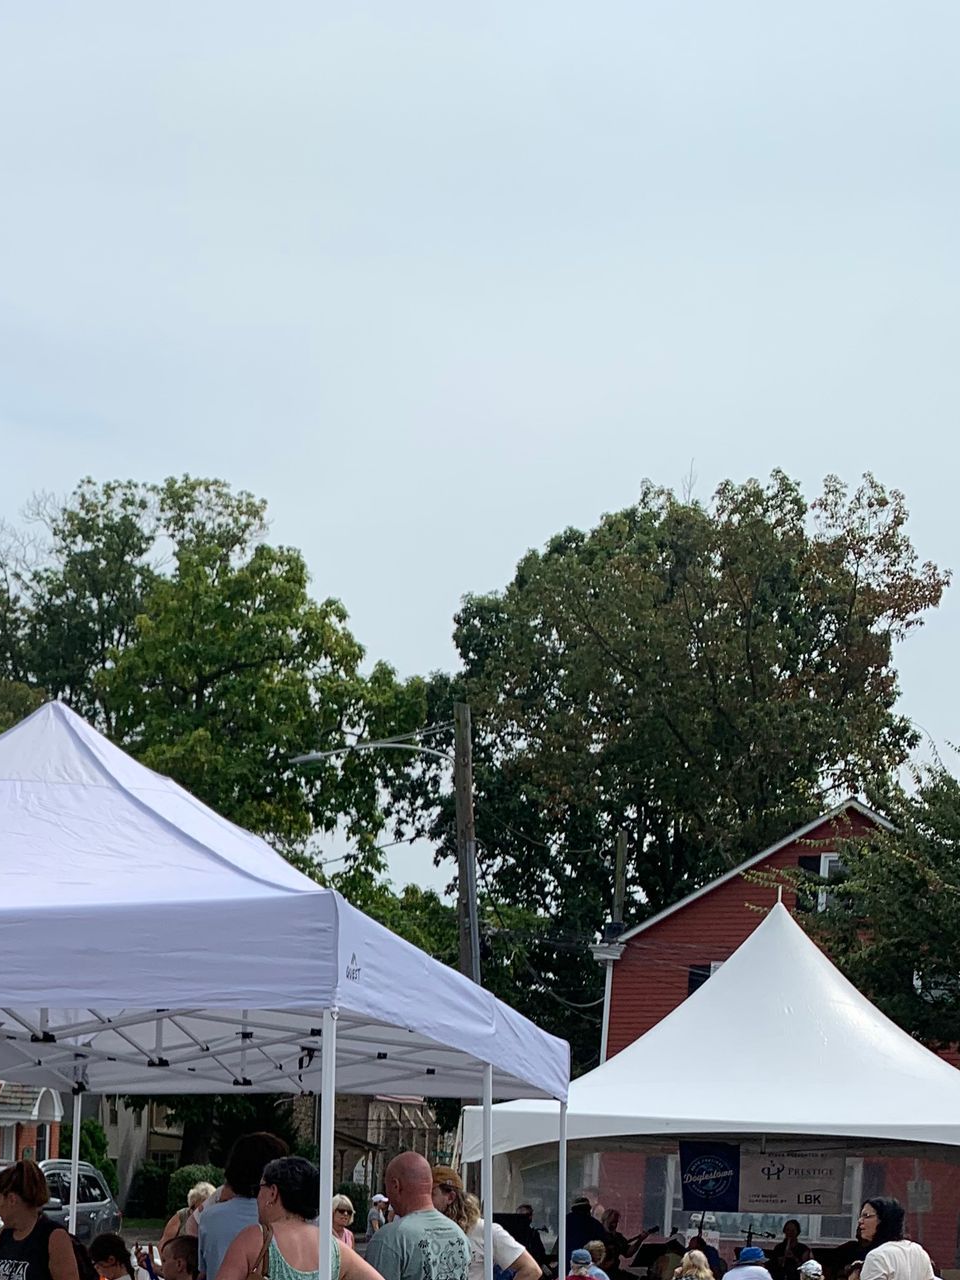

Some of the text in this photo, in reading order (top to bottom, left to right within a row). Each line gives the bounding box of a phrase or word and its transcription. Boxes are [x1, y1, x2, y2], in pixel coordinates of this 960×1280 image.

[683, 1170, 734, 1184] Doylestown
[788, 1168, 834, 1176] PRESTIGE
[797, 1194, 822, 1204] LBK
